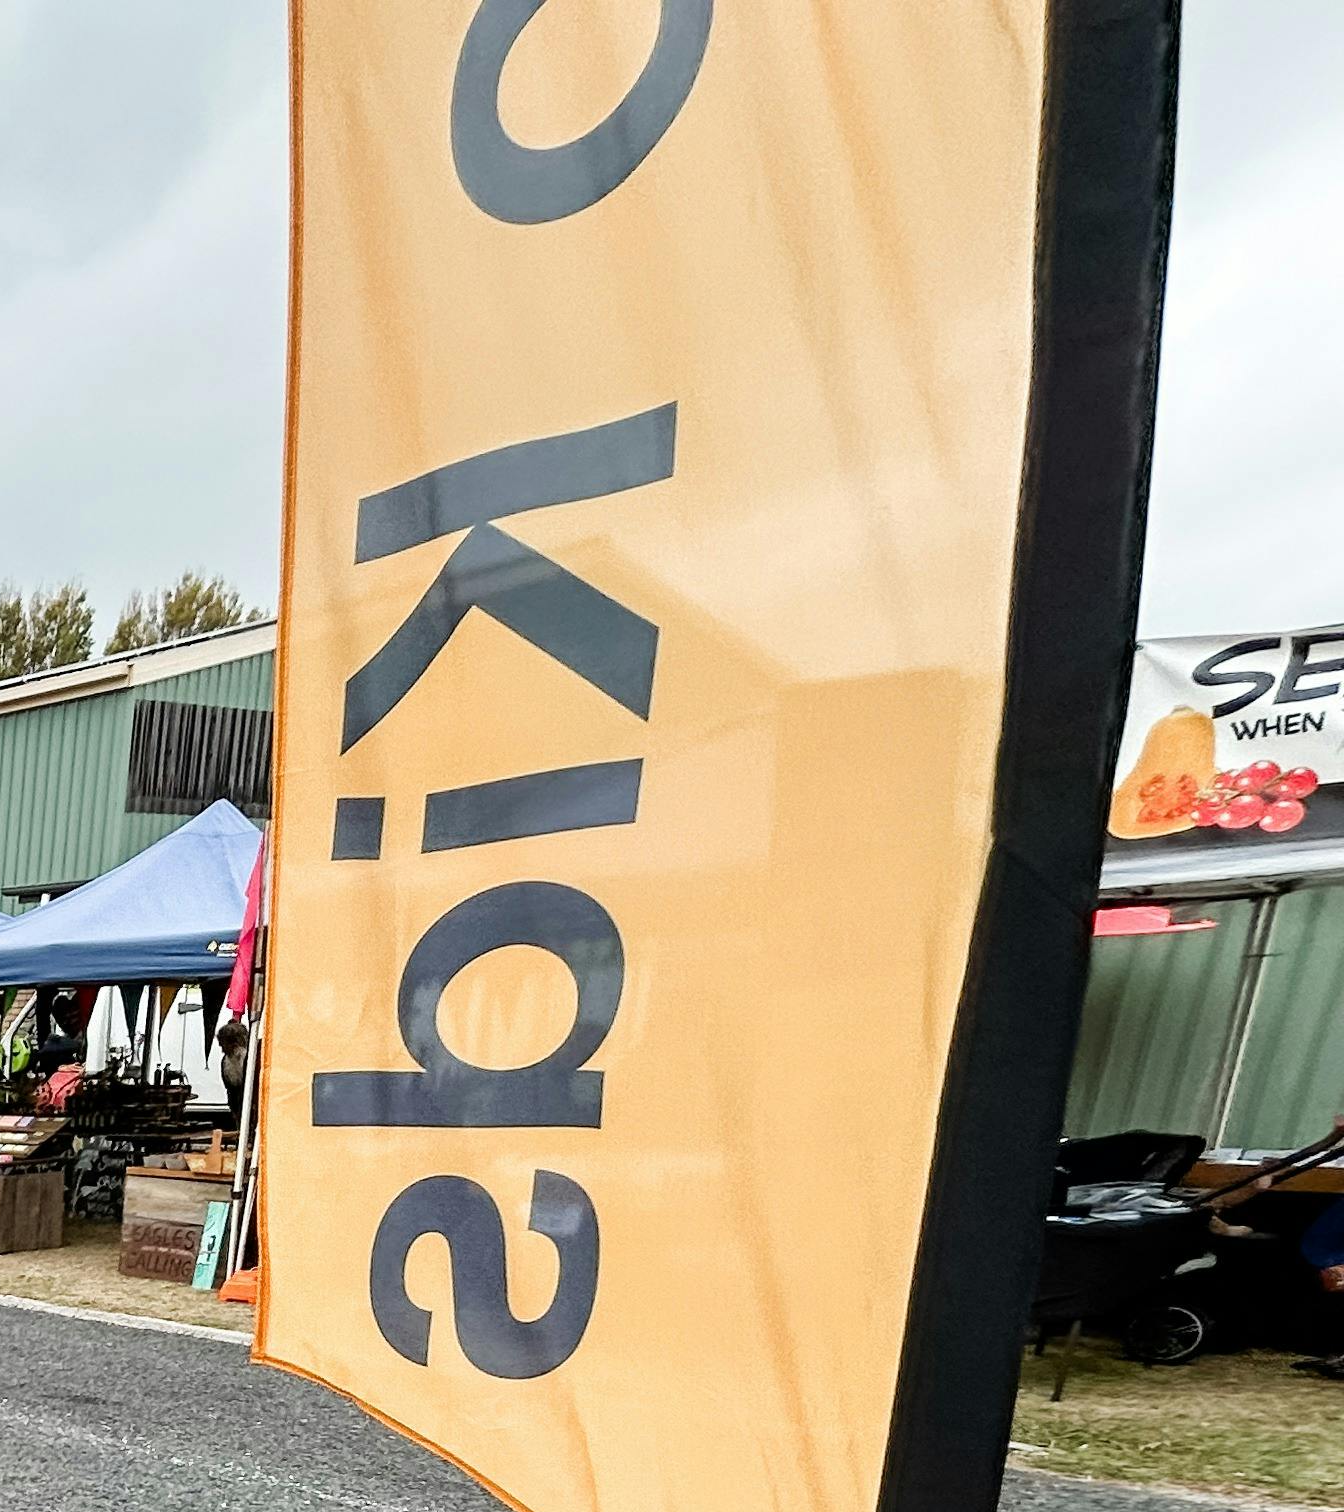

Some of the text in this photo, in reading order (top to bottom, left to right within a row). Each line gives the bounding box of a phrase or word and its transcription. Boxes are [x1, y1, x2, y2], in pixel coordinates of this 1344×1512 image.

[1230, 711, 1326, 741] WHEN
[132, 1225, 196, 1250] EAGLES
[126, 1253, 193, 1277] CALLING
